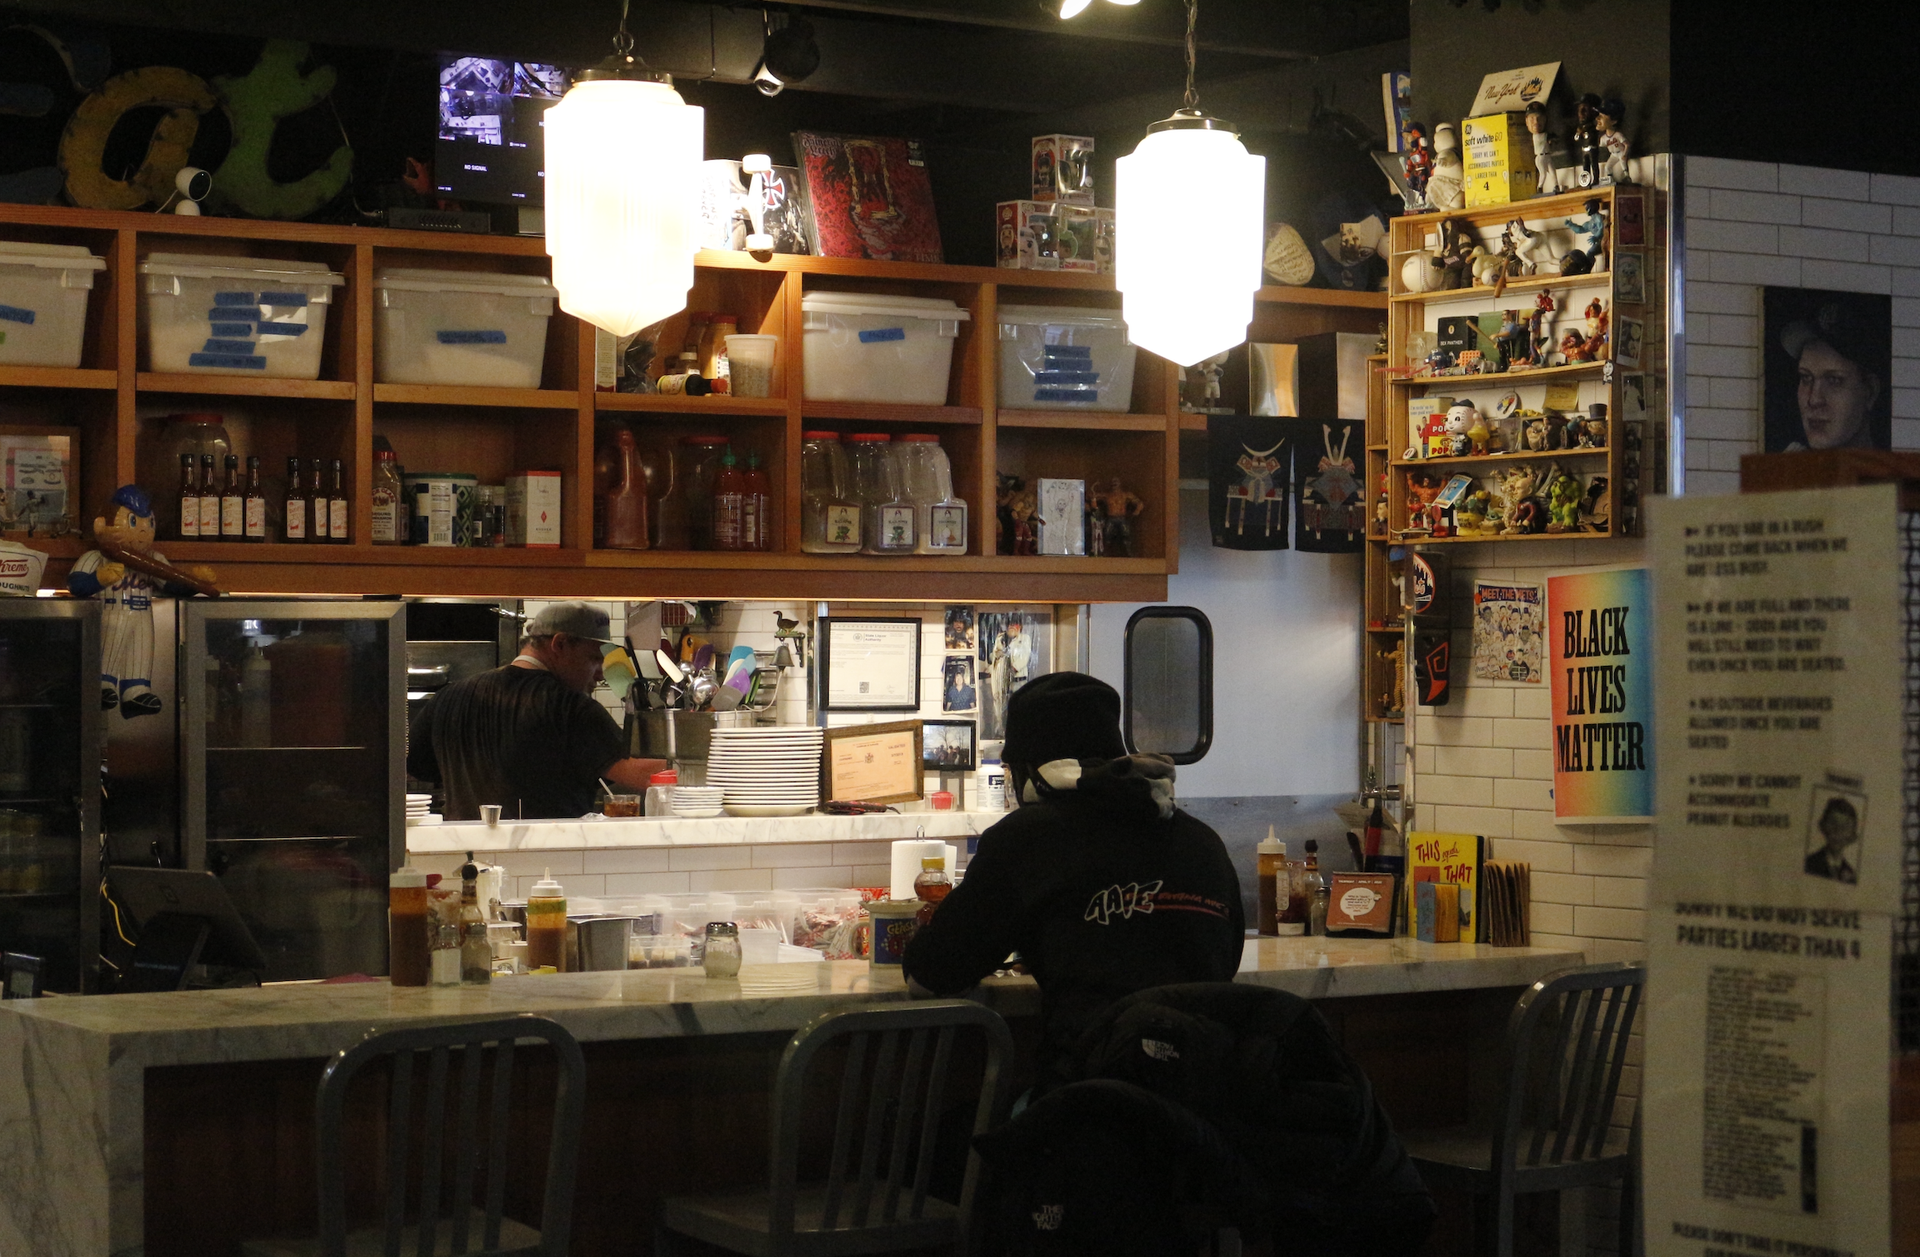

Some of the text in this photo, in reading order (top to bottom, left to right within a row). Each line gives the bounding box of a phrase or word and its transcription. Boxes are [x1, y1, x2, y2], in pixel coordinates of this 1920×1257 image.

[1484, 86, 1500, 100] New
[1495, 82, 1521, 104] York
[1483, 181, 1489, 191] 4
[1481, 588, 1499, 599] MEET
[1501, 588, 1515, 600] THE
[1564, 606, 1630, 658] BLACK
[1567, 664, 1626, 716] LIVES
[1557, 721, 1646, 772] MATTER
[1416, 840, 1440, 863] THIS
[1444, 863, 1472, 884] THAT
[1677, 924, 1738, 949] PARTIES
[1742, 929, 1800, 954] LARGER
[1804, 936, 1845, 958] THAN
